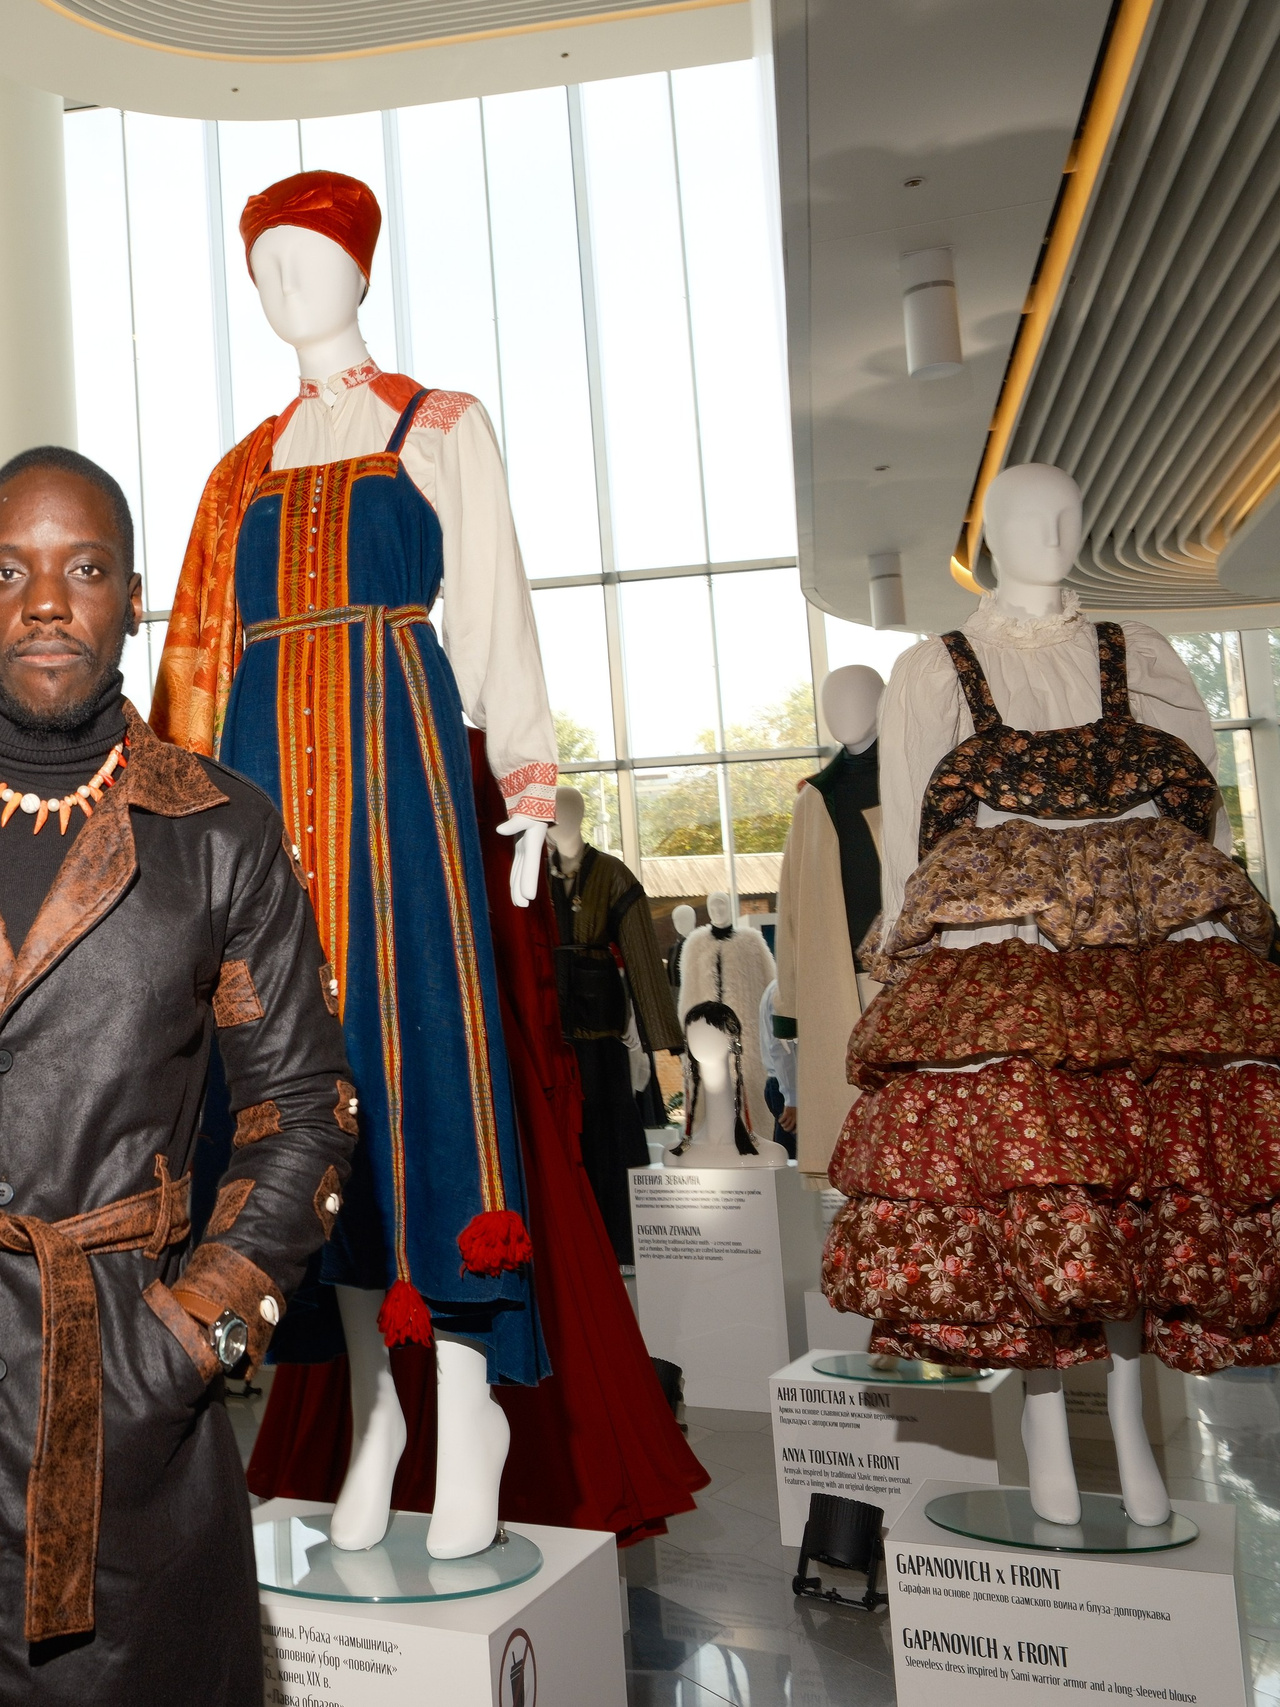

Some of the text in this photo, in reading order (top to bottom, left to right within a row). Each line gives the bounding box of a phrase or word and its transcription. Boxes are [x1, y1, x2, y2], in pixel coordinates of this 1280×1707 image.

[778, 1387, 797, 1401] АНЯ
[800, 1388, 846, 1404] ТОЛСТАЯ
[858, 1391, 890, 1407] FRONT
[783, 1448, 806, 1462] ANYA
[809, 1450, 855, 1466] TOLSTAYA
[867, 1454, 899, 1470] FRONT
[896, 1554, 991, 1582] GAPANOVICH
[1011, 1565, 1061, 1589] FRONT
[899, 1581, 1171, 1621] Сарафан на основе доспехов саамского воина и блуза-долгорукавка
[299, 1626, 330, 1644] Рубаха
[333, 1635, 401, 1654] «намышница»,
[903, 1629, 998, 1659] GAPANOVICH
[1018, 1642, 1068, 1667] FRONT
[276, 1648, 316, 1662] головной
[318, 1651, 340, 1670] убор
[343, 1659, 397, 1675] «повойник»
[278, 1670, 306, 1686] конец
[307, 1671, 321, 1687] XIX
[323, 1677, 331, 1688] в.
[905, 1656, 1196, 1704] Sleeveless dress inspired by Sami warrior armor and a long-sleeved blouse
